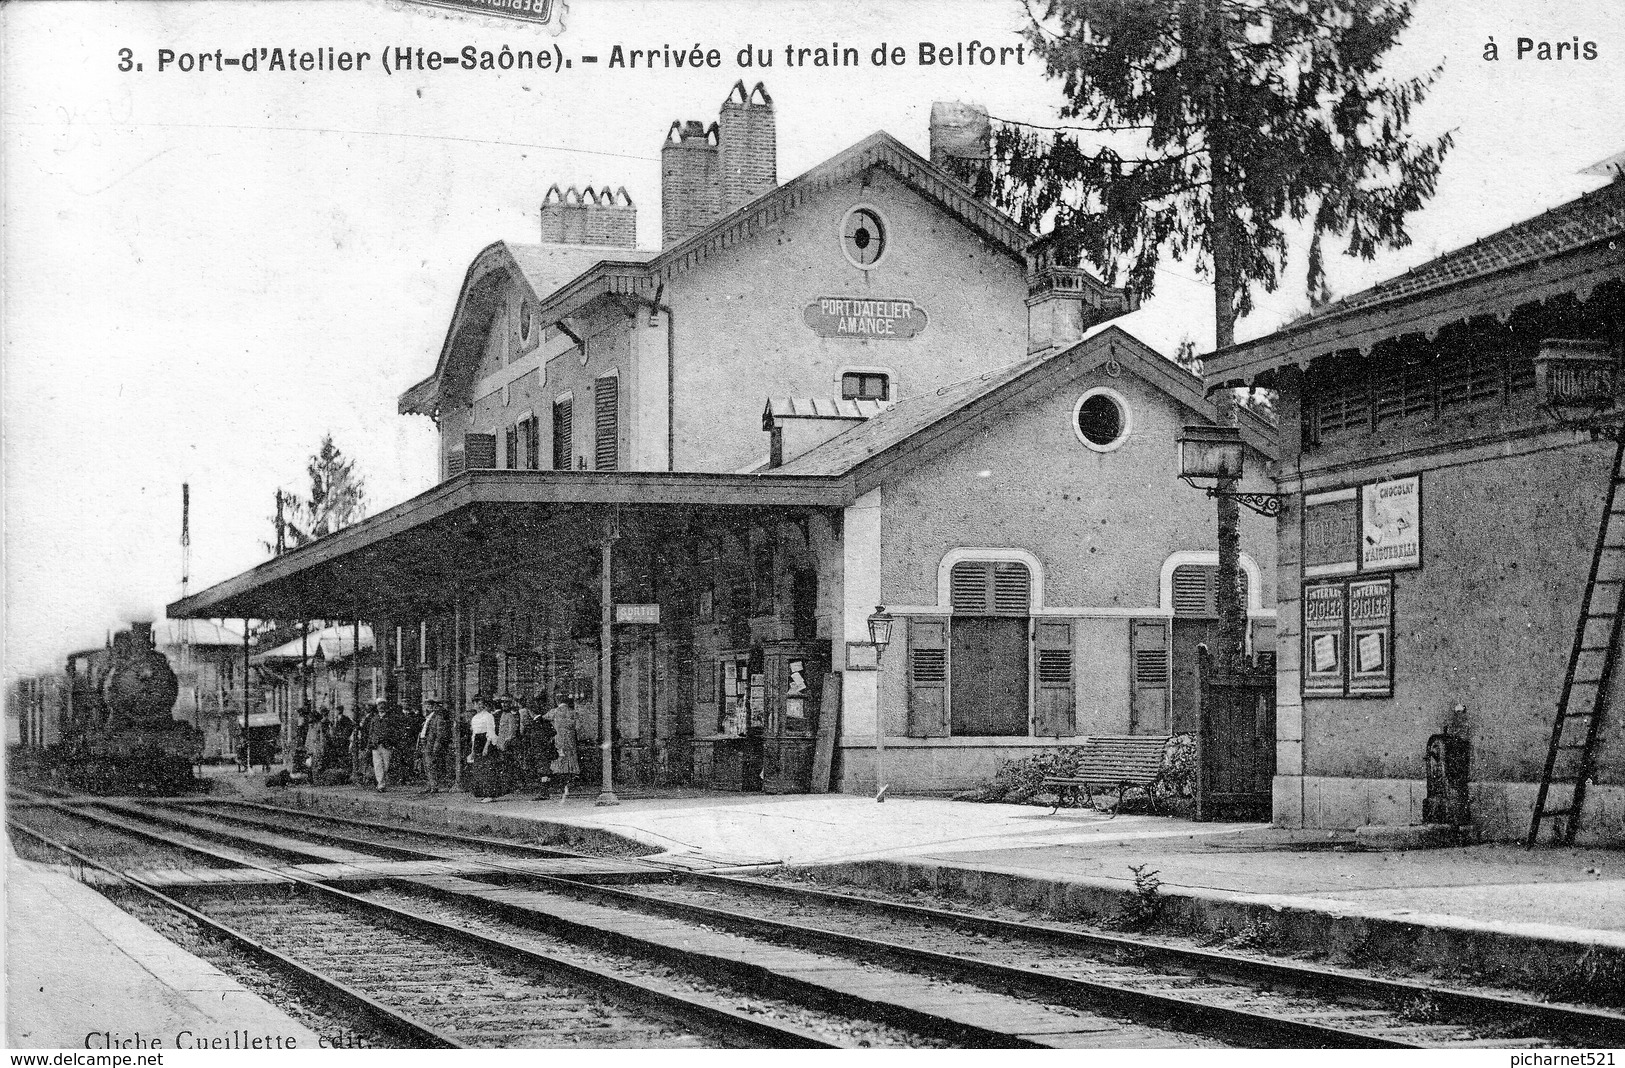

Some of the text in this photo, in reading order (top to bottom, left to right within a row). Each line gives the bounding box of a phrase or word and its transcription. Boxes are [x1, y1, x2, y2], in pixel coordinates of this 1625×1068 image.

[821, 299, 851, 316] PORT
[837, 316, 897, 335] AMANCE
[620, 606, 656, 616] SORTIE
